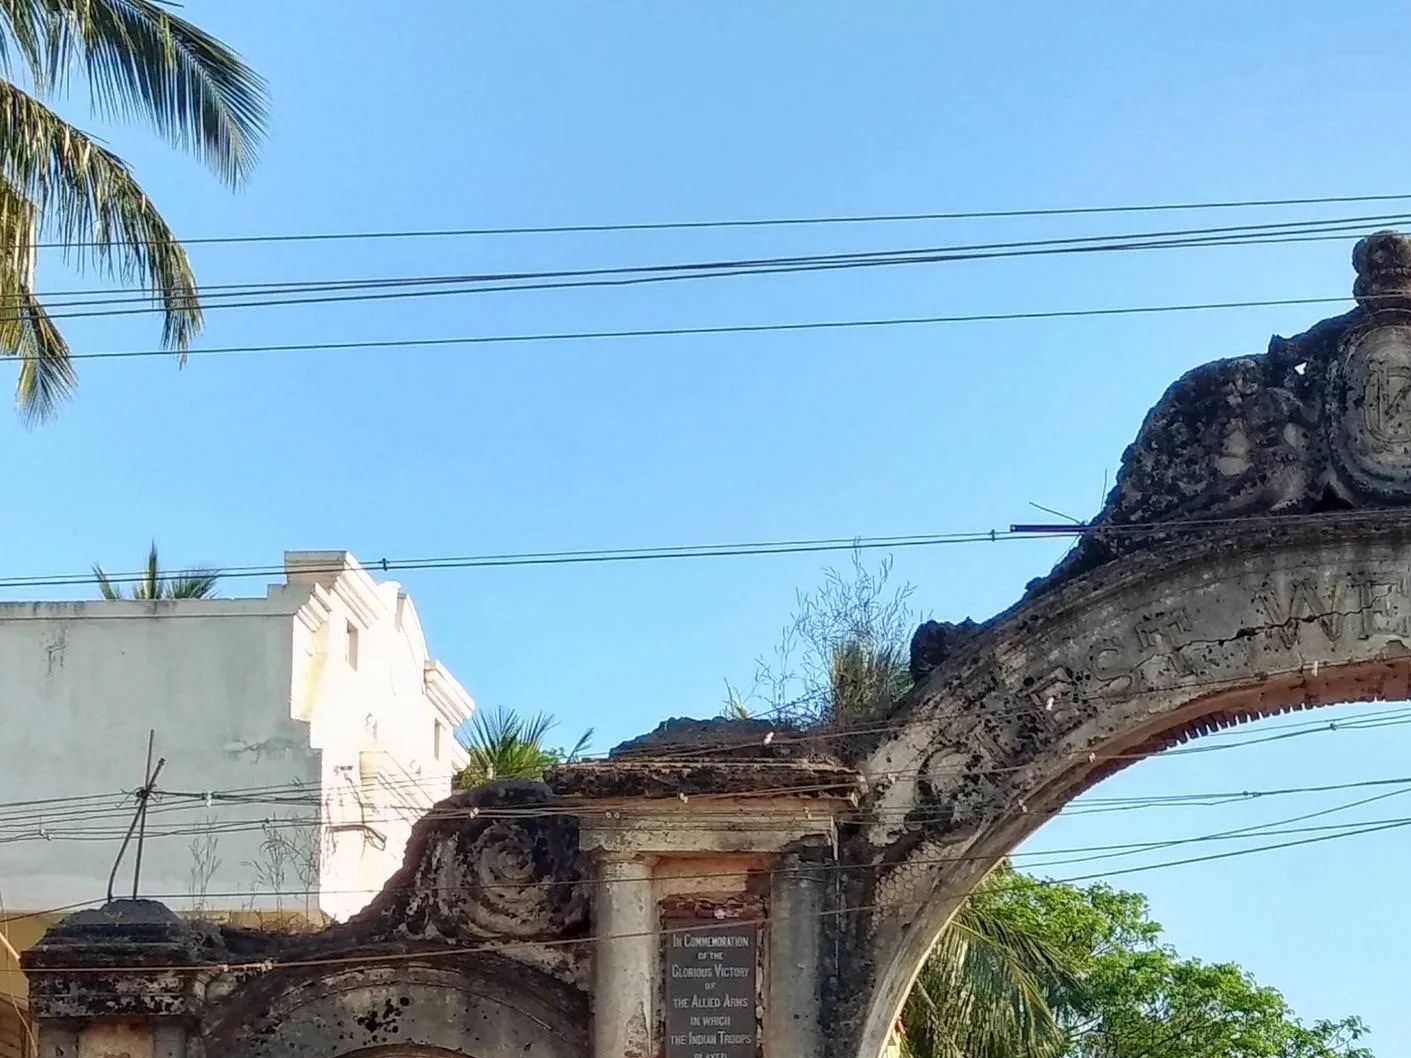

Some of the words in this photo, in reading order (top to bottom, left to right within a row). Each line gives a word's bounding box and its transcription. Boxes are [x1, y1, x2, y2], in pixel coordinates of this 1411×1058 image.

[1251, 577, 1411, 650] WE
[673, 933, 682, 948] IN
[684, 933, 750, 948] COMMEMORATION
[697, 951, 707, 960] OF
[709, 951, 723, 960] THE
[672, 963, 713, 978] GLORIOUS
[714, 963, 750, 977] VICTORY
[704, 982, 717, 990] OF
[673, 998, 689, 1009] THE
[691, 993, 721, 1008] ALLIED
[723, 993, 749, 1008] ARMS
[690, 1015, 701, 1026] IN
[702, 1015, 731, 1026] WHICH
[671, 1034, 687, 1045] THE
[688, 1031, 717, 1045] INDIAN
[717, 1030, 752, 1045] TROOPS
